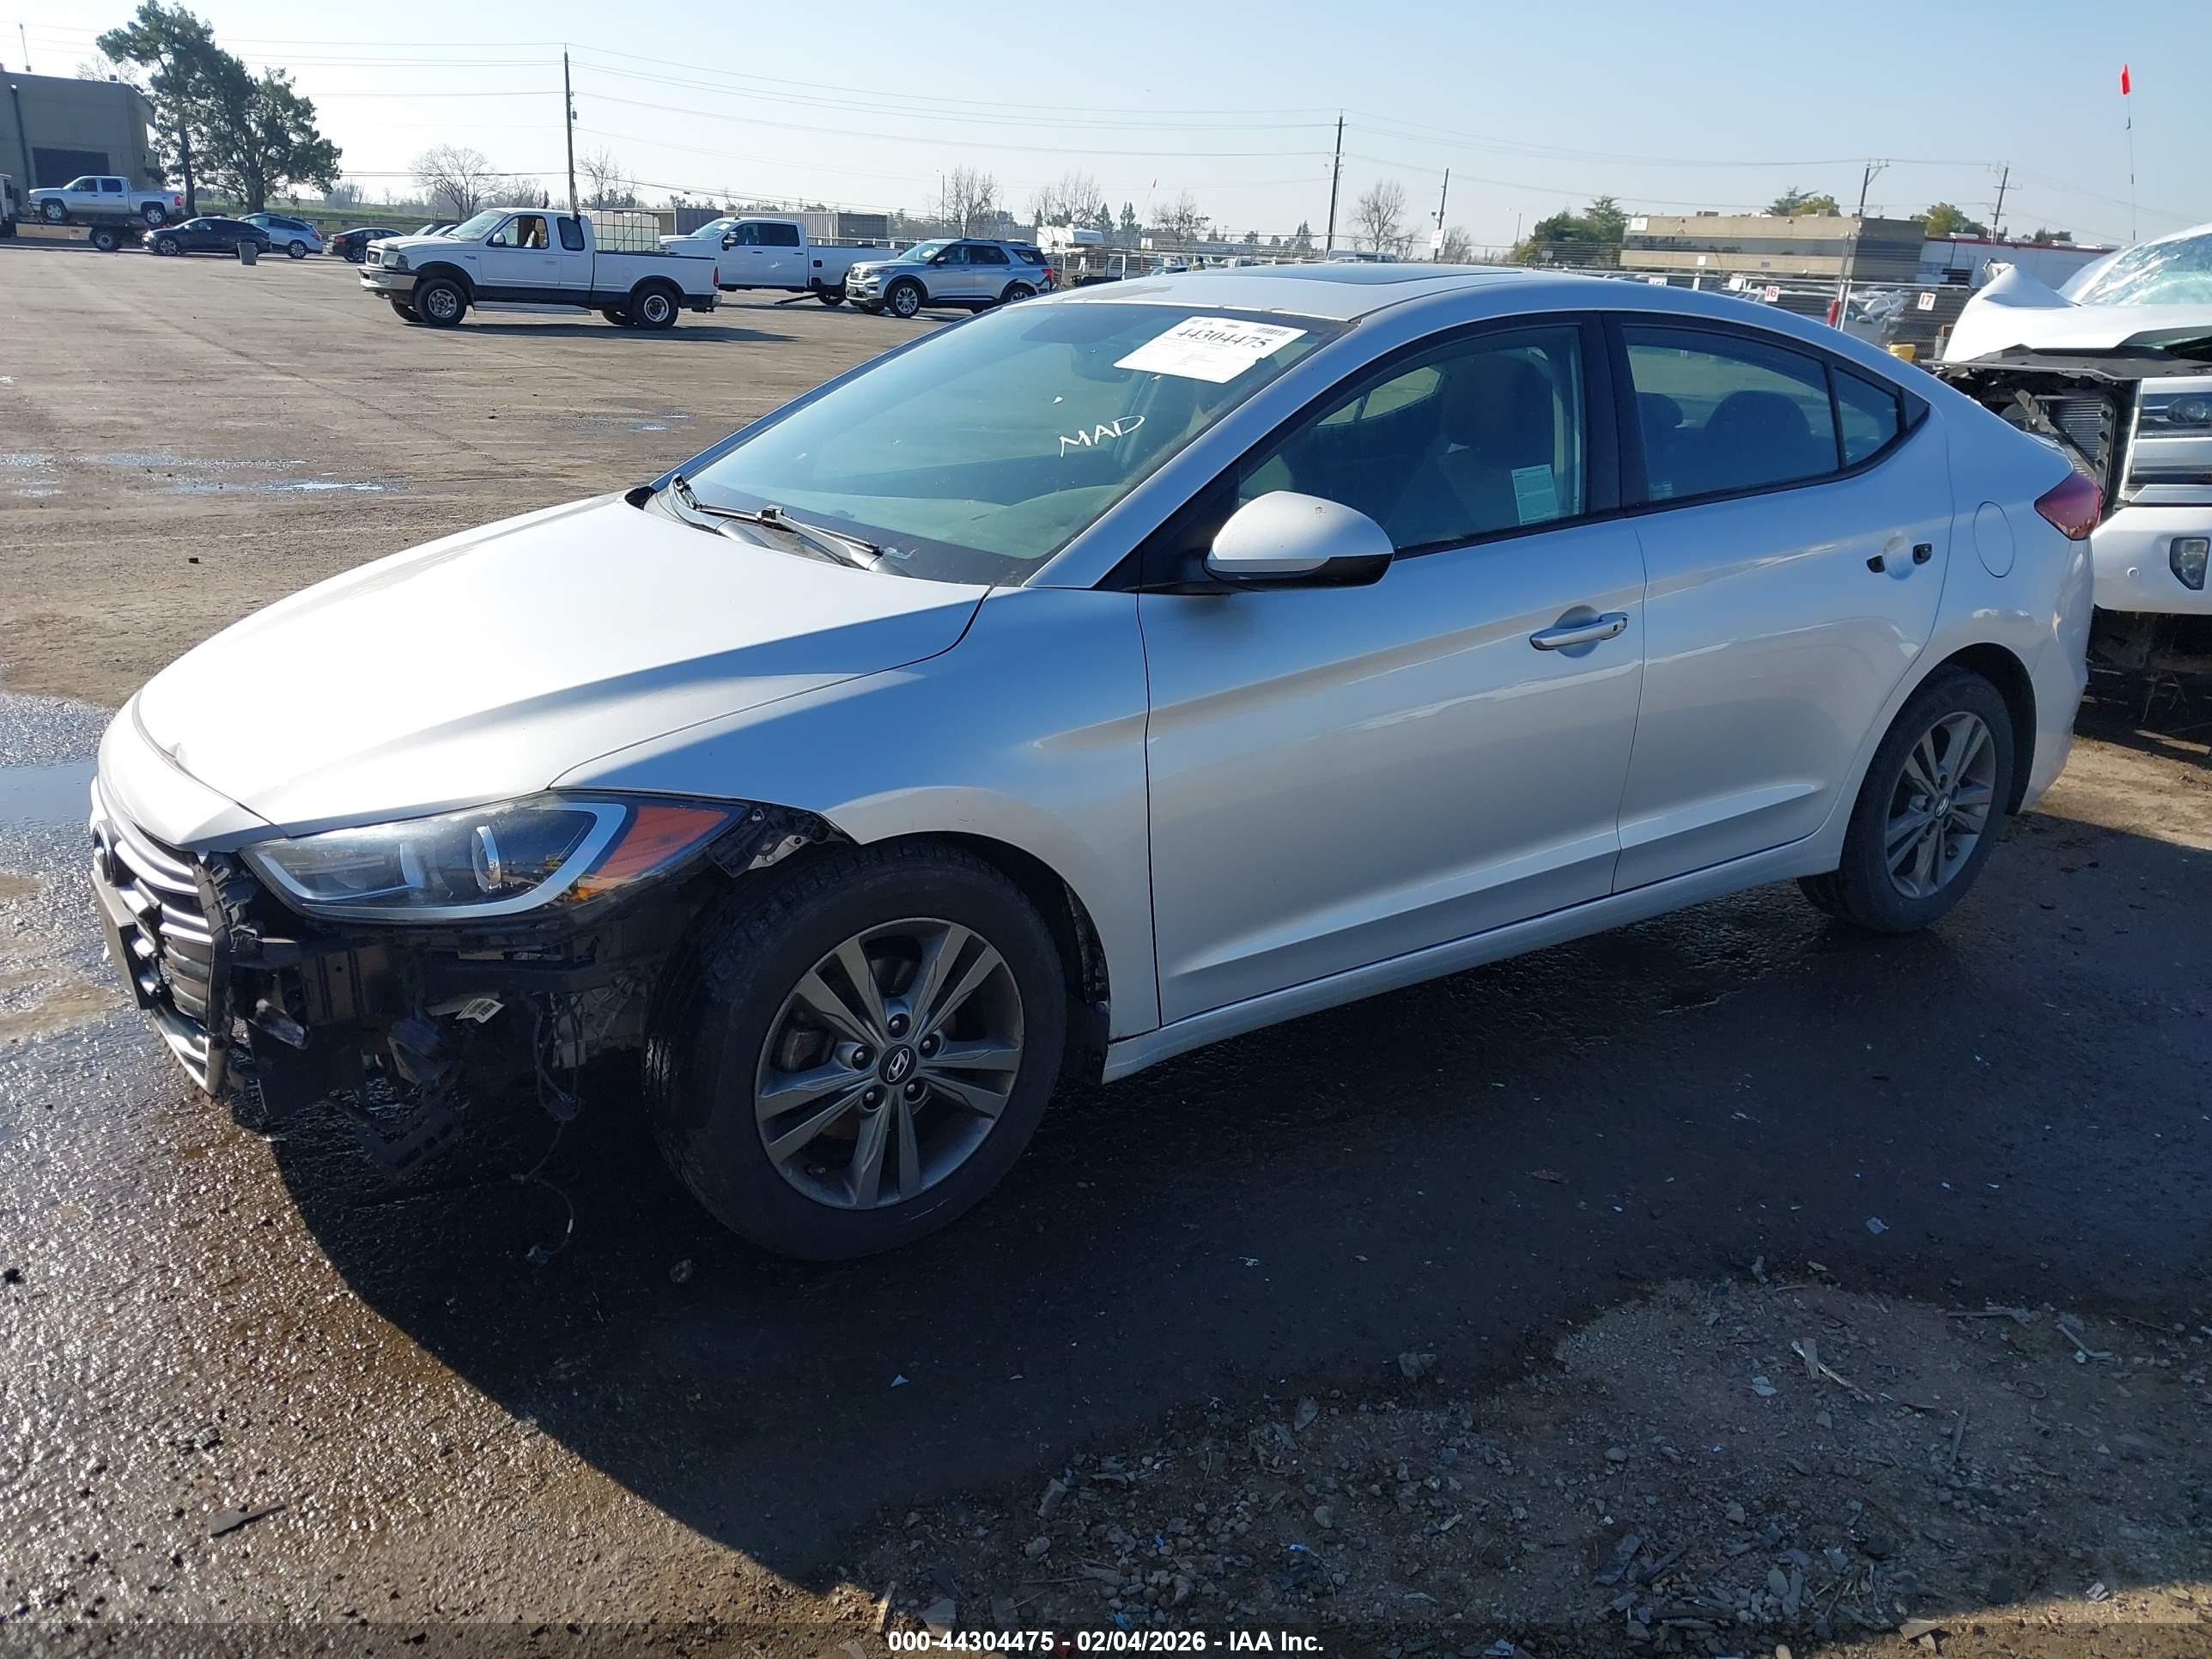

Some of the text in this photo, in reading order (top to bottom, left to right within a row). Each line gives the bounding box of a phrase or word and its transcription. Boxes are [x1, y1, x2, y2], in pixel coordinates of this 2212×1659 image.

[1766, 288, 1778, 297] 16
[1921, 295, 1934, 306] 17
[1059, 416, 1145, 458] MAD
